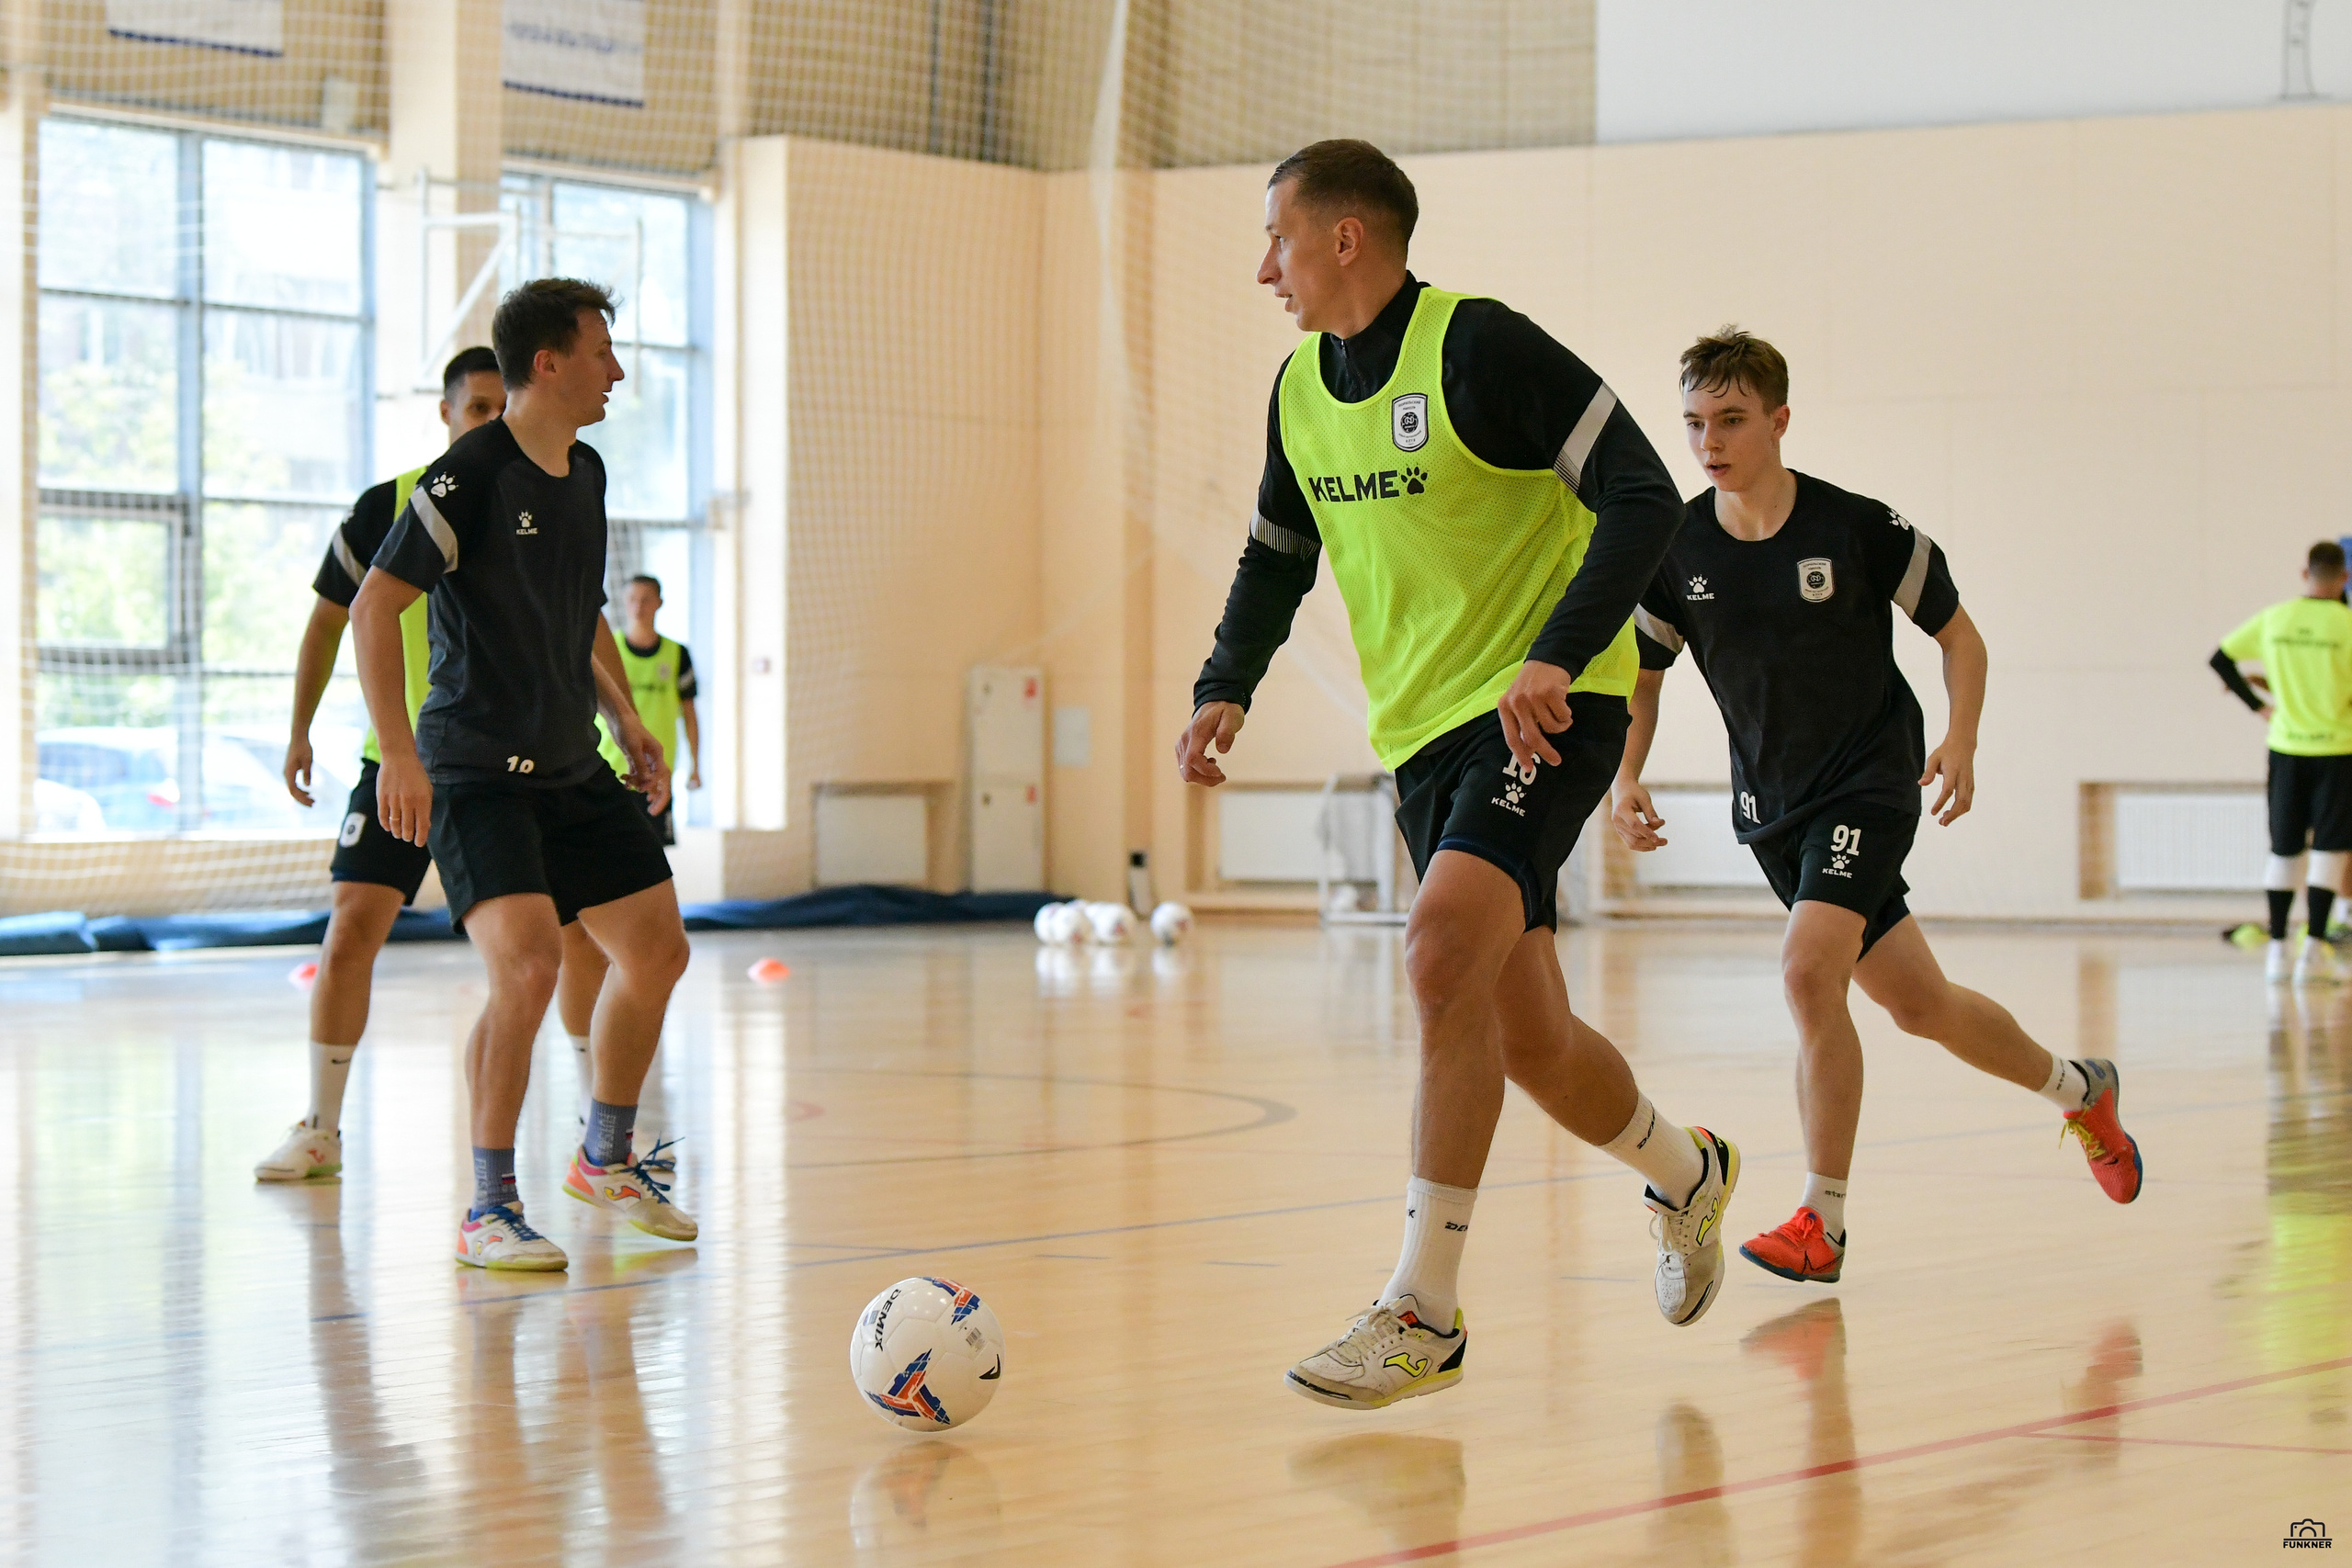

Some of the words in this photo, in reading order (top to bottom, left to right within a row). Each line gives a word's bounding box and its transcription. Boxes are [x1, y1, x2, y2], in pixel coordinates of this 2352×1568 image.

[1308, 470, 1399, 502] KELME
[1686, 592, 1715, 601] KELME
[1491, 796, 1526, 817] KELME
[1740, 791, 1761, 825] 91
[1830, 824, 1861, 856] 91
[1822, 867, 1853, 879] KELME
[875, 1289, 901, 1351] DEMIX
